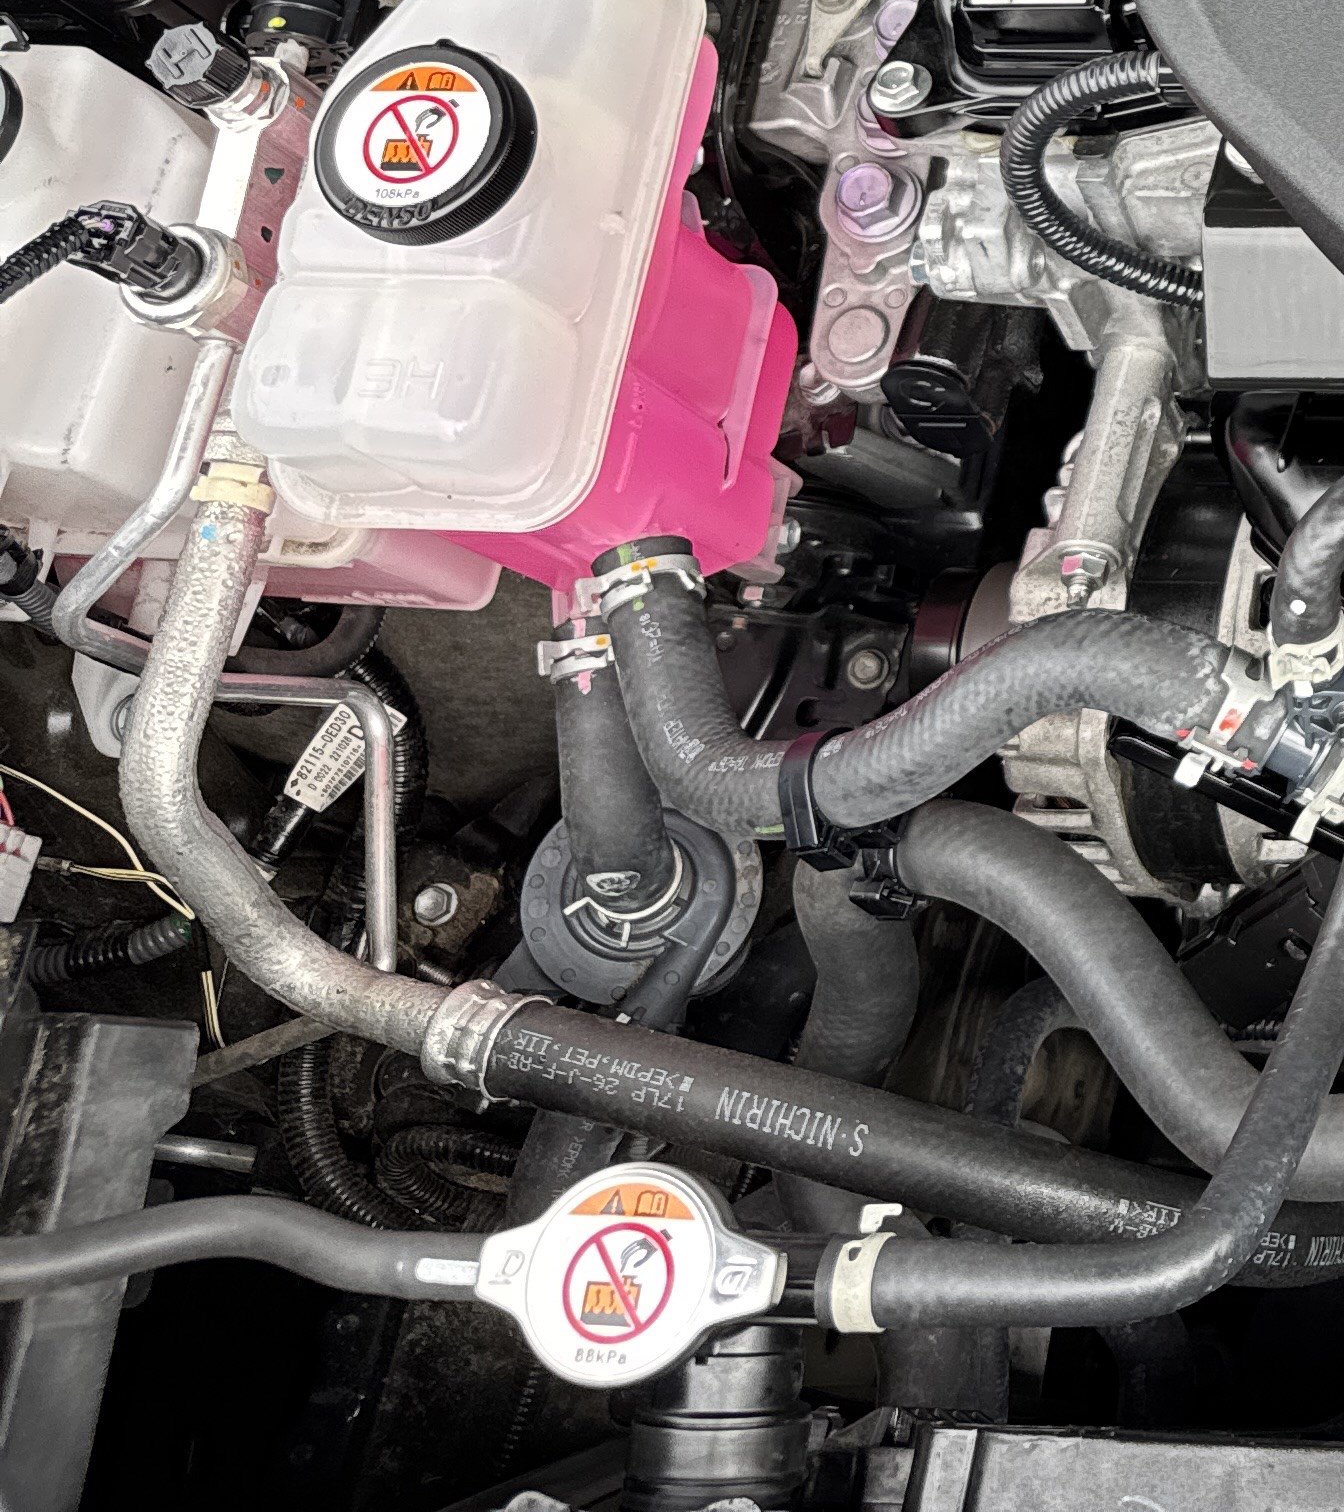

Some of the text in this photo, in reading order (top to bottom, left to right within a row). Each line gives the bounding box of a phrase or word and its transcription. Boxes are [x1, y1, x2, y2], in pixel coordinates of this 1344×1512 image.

[375, 188, 419, 199] 108kPa
[343, 196, 432, 228] DENSO
[297, 707, 351, 781] 82115-0ED30
[631, 1084, 687, 1114] 17LP
[574, 1348, 626, 1364] 88kPa
